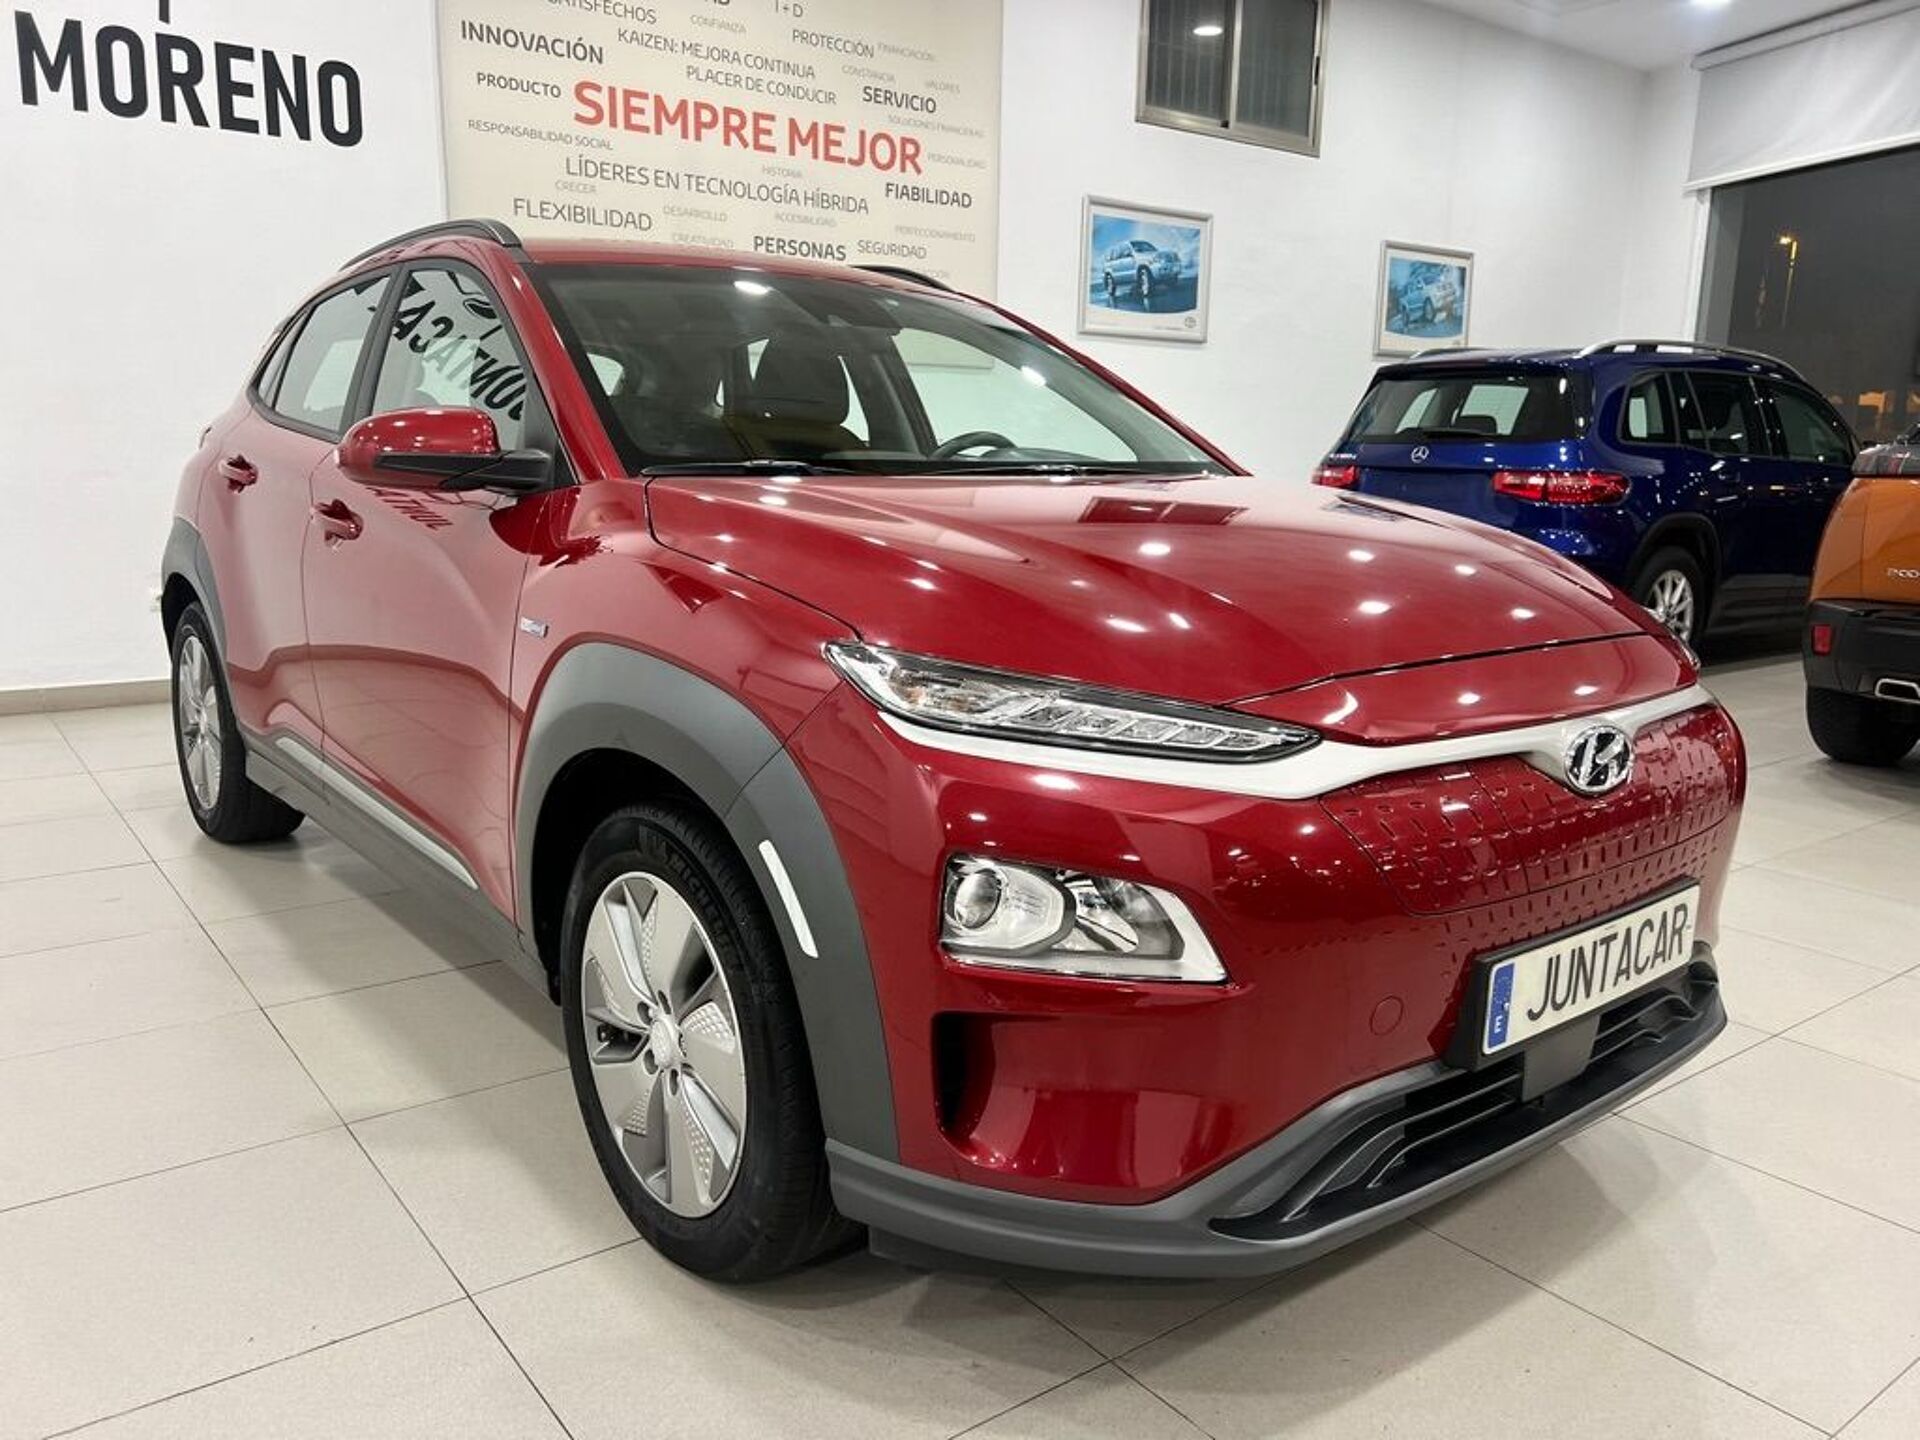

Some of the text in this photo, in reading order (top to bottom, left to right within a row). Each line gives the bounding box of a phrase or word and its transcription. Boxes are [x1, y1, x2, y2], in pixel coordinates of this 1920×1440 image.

[461, 19, 604, 65] INNOVACIÓN
[617, 27, 816, 80] KAIZEN: MEJORA CONTINUA
[792, 28, 874, 59] PROTECCIÓN
[15, 10, 363, 147] MORENO
[476, 71, 562, 99] PRODUCTO
[686, 64, 837, 106] PLACER DE CONDUCIR
[861, 84, 937, 114] SERVICIO
[468, 118, 614, 152] RESPONSABILIDAD SOCIAL
[573, 79, 922, 176] SIEMPRE MEJOR
[565, 155, 870, 215] LÍDERES EN TECNOLOGÍA HÍBRIDA
[884, 182, 972, 209] FIABILIDAD
[513, 198, 653, 232] FLEXIBILIDAD
[752, 234, 846, 262] PERSONAS
[856, 239, 927, 260] SEGURIDAD
[1527, 903, 1688, 1021] JUNTACAR
[1494, 1015, 1503, 1034] E
